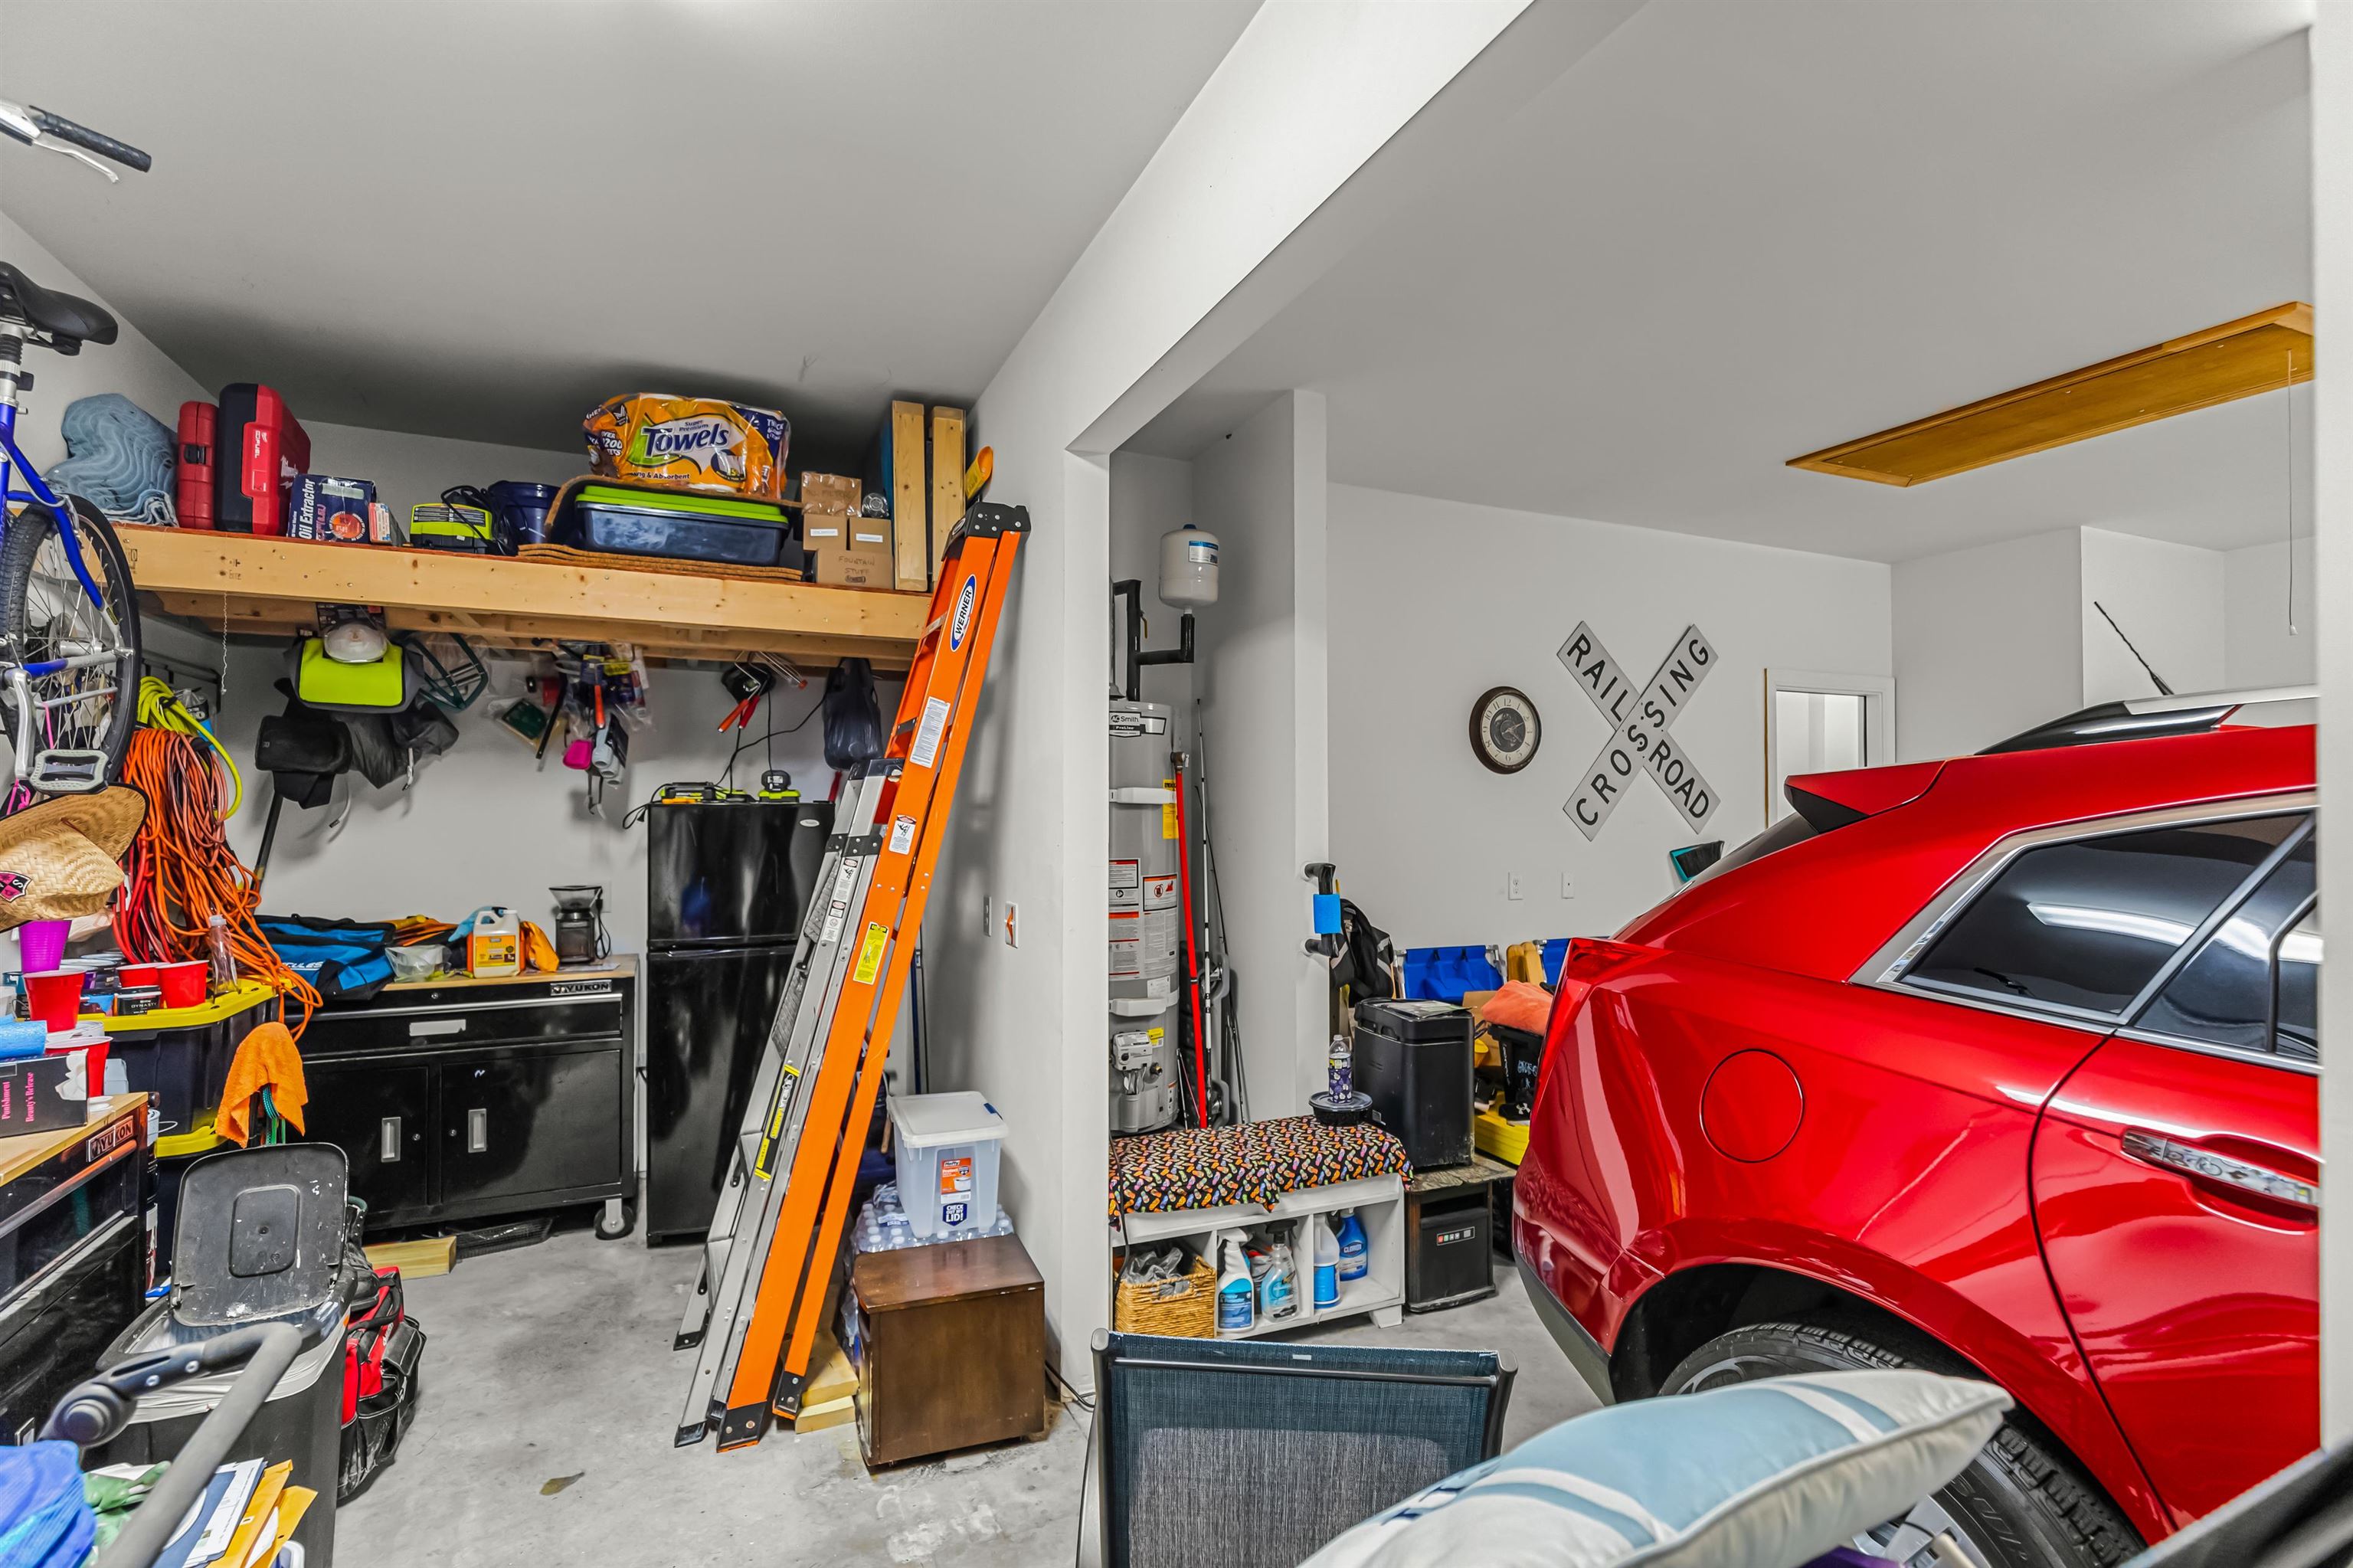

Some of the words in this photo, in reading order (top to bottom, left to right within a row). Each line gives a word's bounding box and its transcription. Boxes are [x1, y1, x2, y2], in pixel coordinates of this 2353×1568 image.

[643, 423, 729, 457] Towels
[299, 479, 315, 524] Extractor
[299, 525, 313, 539] Oil
[955, 590, 972, 635] WERNER
[1566, 633, 1628, 722] RAIL
[1504, 698, 1512, 706] 12
[1576, 639, 1710, 826] CROSSING
[1648, 739, 1710, 818] ROAD
[567, 984, 609, 992] YUKON
[2, 1082, 10, 1120] Punishment
[25, 1072, 34, 1096] Release
[25, 1096, 36, 1122] Beauty's
[946, 1213, 964, 1222] LID!
